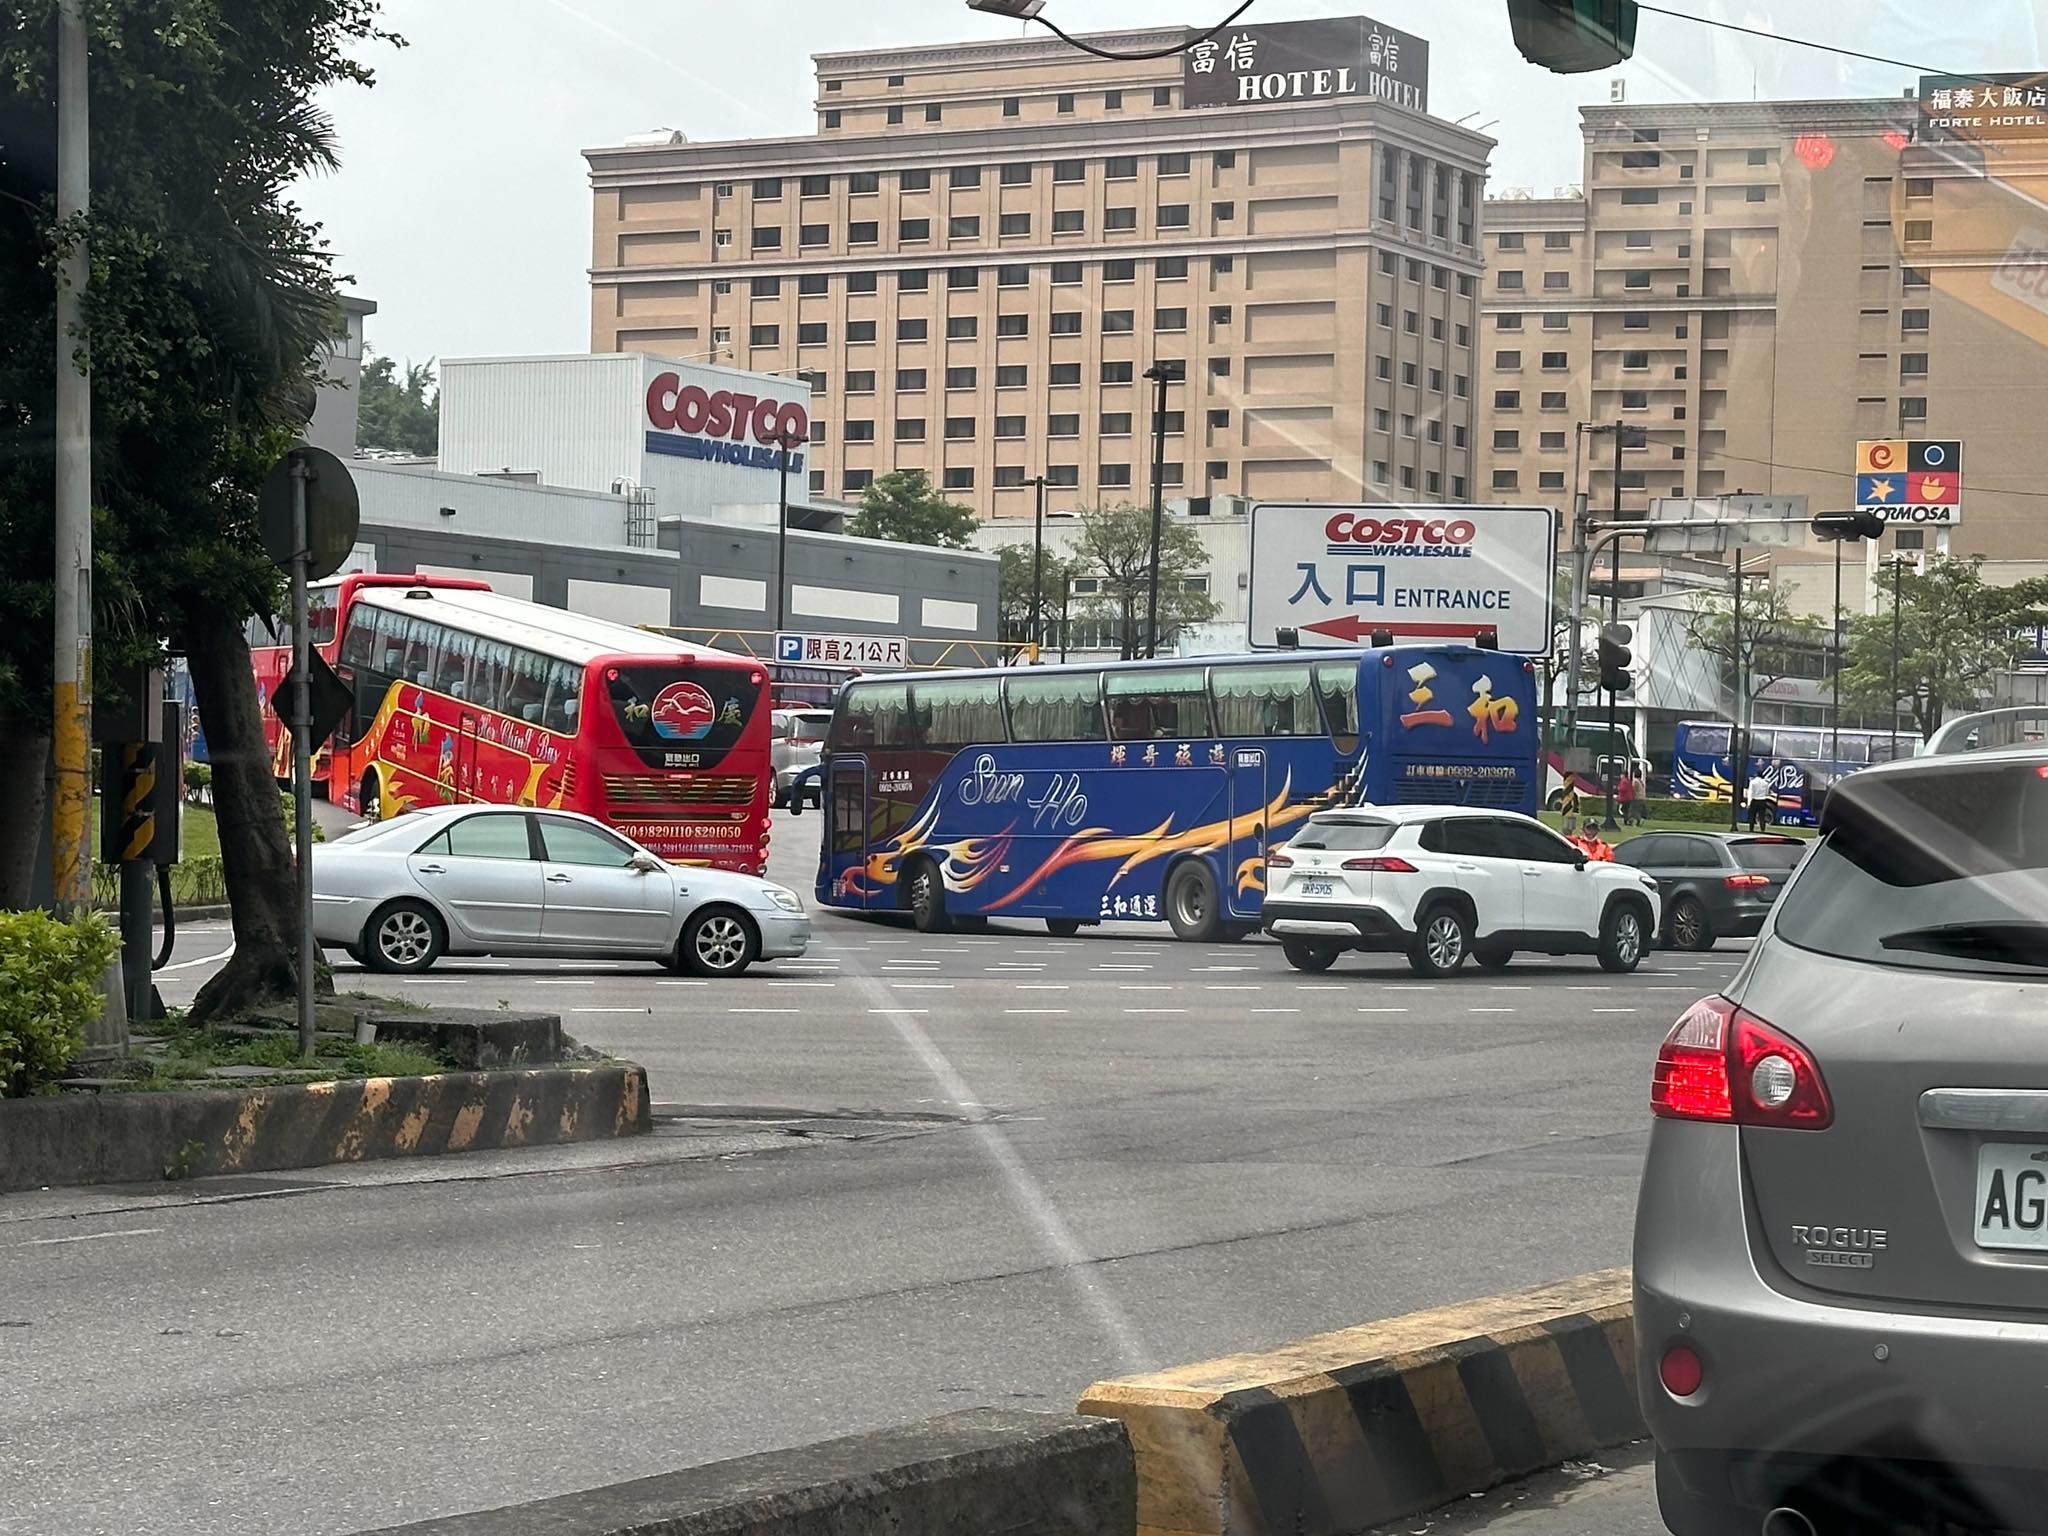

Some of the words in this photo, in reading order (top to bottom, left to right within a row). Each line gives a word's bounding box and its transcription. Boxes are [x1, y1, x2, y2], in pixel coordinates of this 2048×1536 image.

[1187, 33, 1258, 74] 富信
[1368, 25, 1400, 73] 富信
[1237, 67, 1356, 101] HOTEL
[1368, 70, 1423, 112] HOTEL
[1931, 86, 2047, 110] 福泰大飯店
[1929, 117, 1982, 128] FORTE
[1989, 115, 2046, 127] HOTEL
[646, 371, 808, 449] COSTCO
[1325, 512, 1476, 545] COSTCO
[1371, 544, 1472, 558] WHOLESALE
[1288, 562, 1386, 607] 入口
[1394, 588, 1511, 610] ENTRANCE
[1400, 661, 1519, 745] 三和
[1980, 1168, 2048, 1231] AG
[1791, 1224, 1888, 1250] ROGUE
[1811, 1252, 1869, 1266] SELECT
